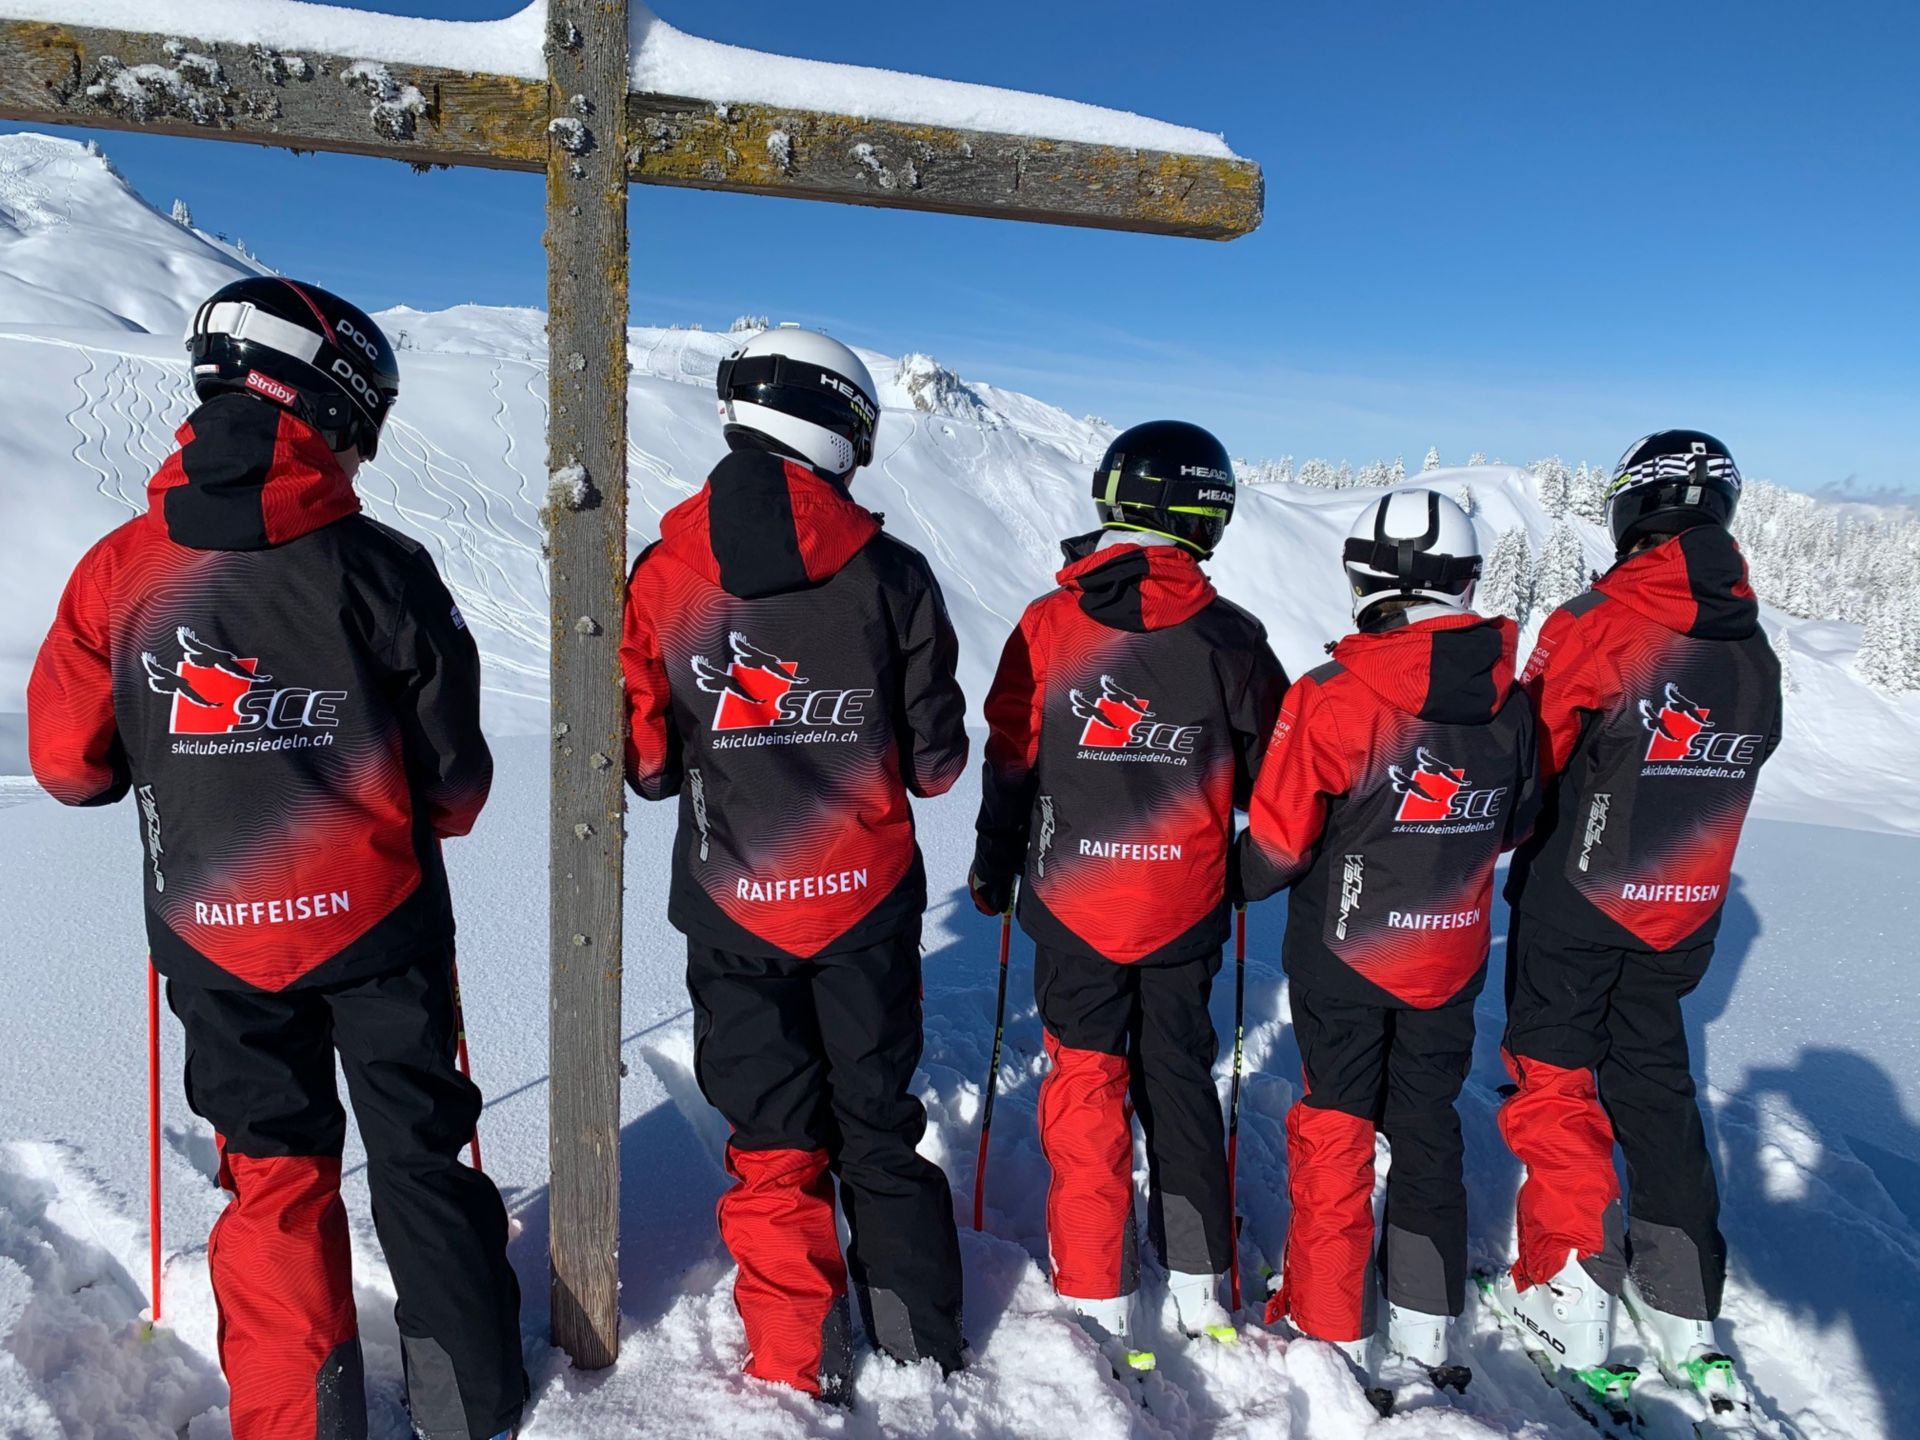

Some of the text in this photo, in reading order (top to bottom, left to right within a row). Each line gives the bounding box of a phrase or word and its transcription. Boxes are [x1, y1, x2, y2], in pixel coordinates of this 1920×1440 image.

[247, 371, 296, 403] Strüby
[820, 373, 876, 422] HEAD
[1180, 465, 1228, 481] HEAD
[1198, 488, 1234, 505] HEAD
[227, 687, 348, 734] SCE
[769, 689, 875, 728] SCE
[171, 732, 334, 756] skiclubeinsiedeln.ch
[712, 730, 859, 750] skiclubeinsiedeln.ch
[1122, 720, 1203, 754] SCE
[1679, 731, 1764, 765] SCE
[1076, 749, 1189, 767] skiclubeinsiedeln.ch
[1640, 764, 1747, 780] skiclubeinsiedeln.ch
[1441, 786, 1508, 821] SCE
[1593, 793, 1612, 845] PURA
[1391, 820, 1496, 836] skiclubeinsiedeln.ch
[1579, 793, 1602, 872] ENERGIA
[1079, 838, 1182, 861] RAIFFEISEN
[736, 868, 868, 902] RAIFFEISEN
[1335, 854, 1354, 941] ENERGIA
[1350, 854, 1364, 910] PURA
[1620, 883, 1721, 903] RAIFFEISEN
[195, 890, 350, 926] RAIFFEISEN
[1387, 907, 1481, 931] RAIFFEISEN
[1513, 1306, 1566, 1356] HEAD
